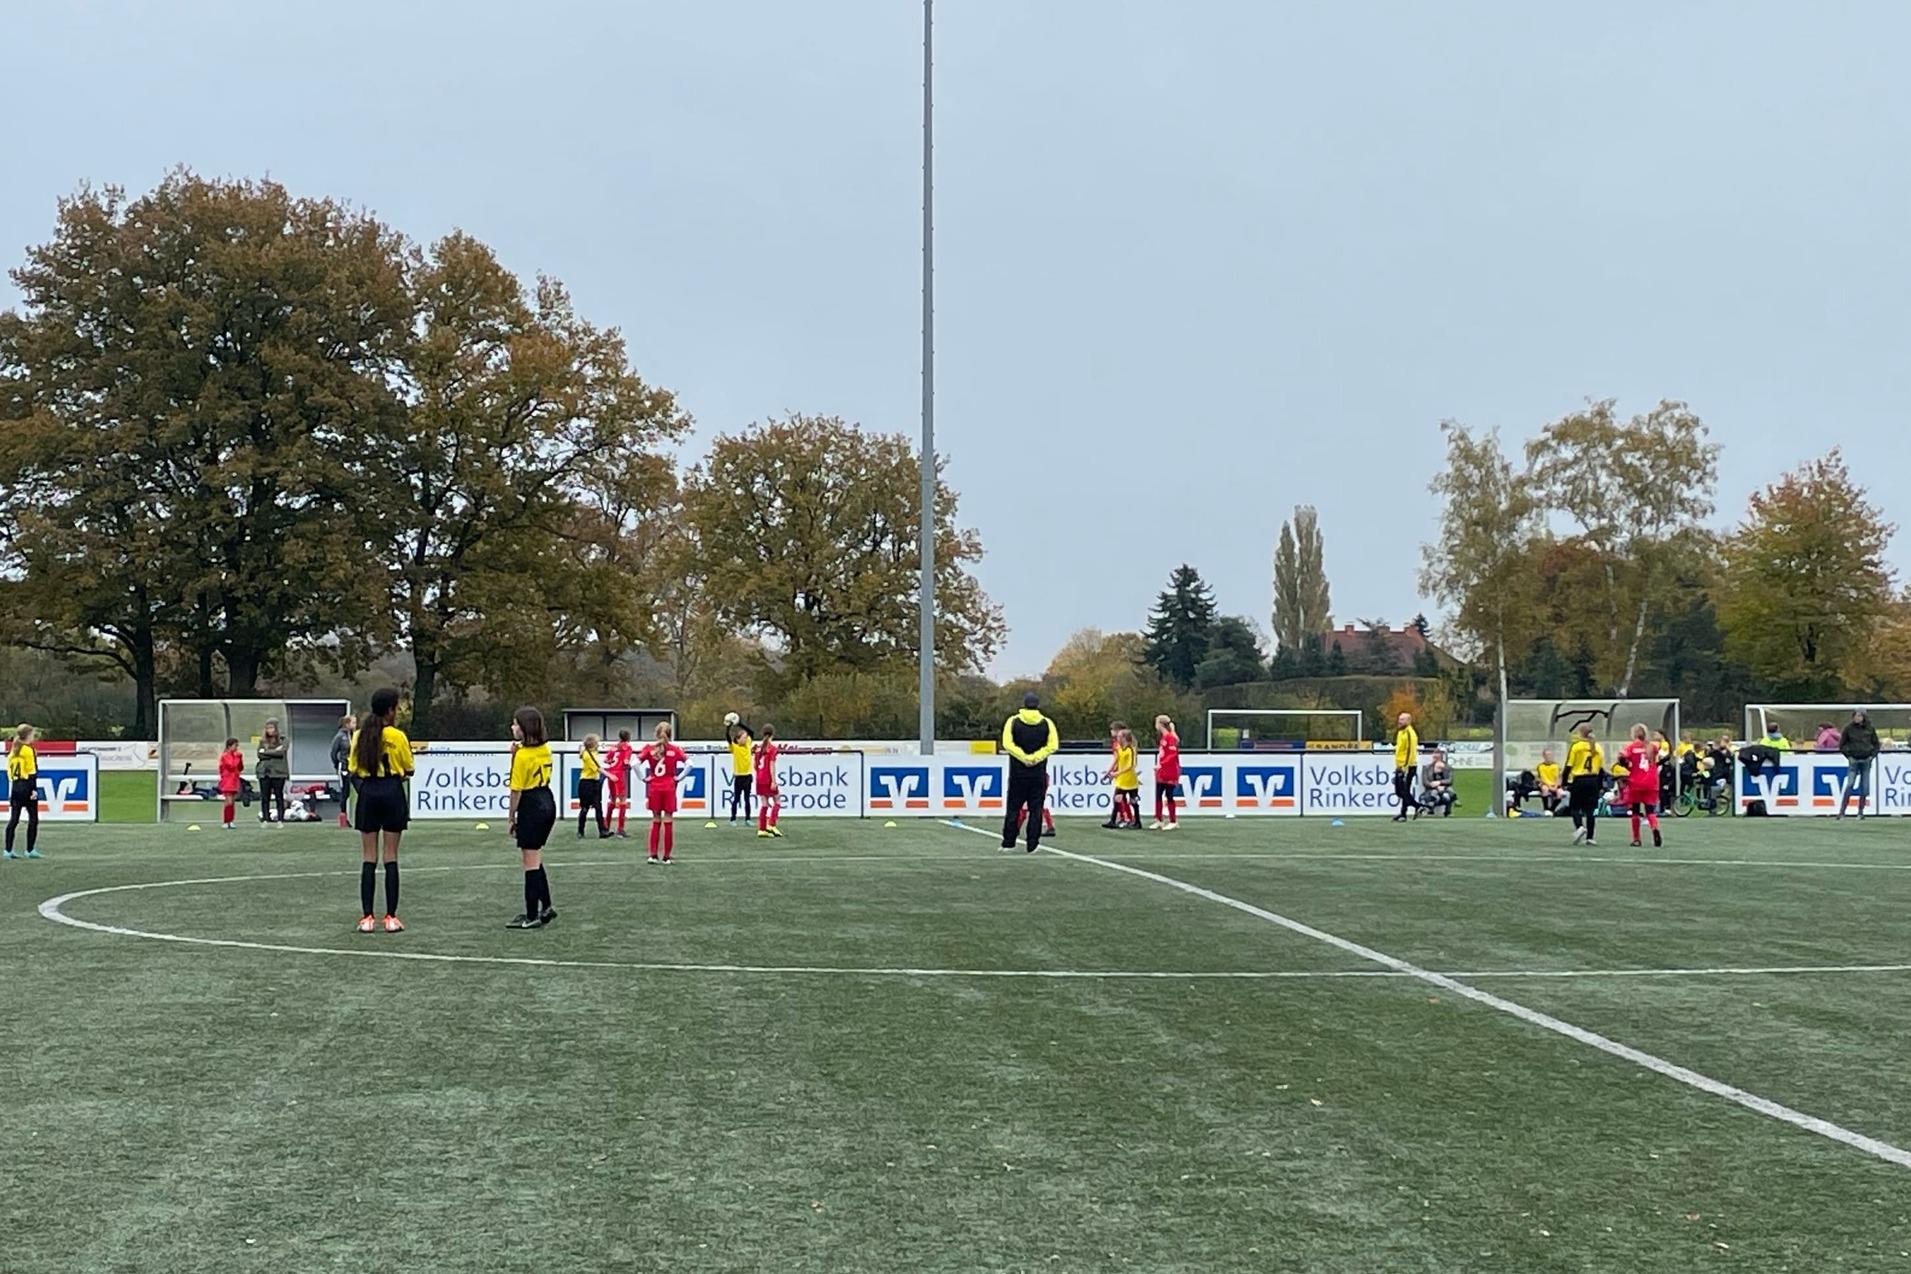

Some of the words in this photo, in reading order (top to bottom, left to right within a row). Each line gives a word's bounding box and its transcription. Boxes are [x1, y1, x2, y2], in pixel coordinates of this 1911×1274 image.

[654, 757, 666, 777] 6
[1639, 753, 1650, 772] 4
[721, 765, 849, 787] Vsbank
[418, 789, 511, 811] Rinkero
[1310, 787, 1402, 808] Rinkero
